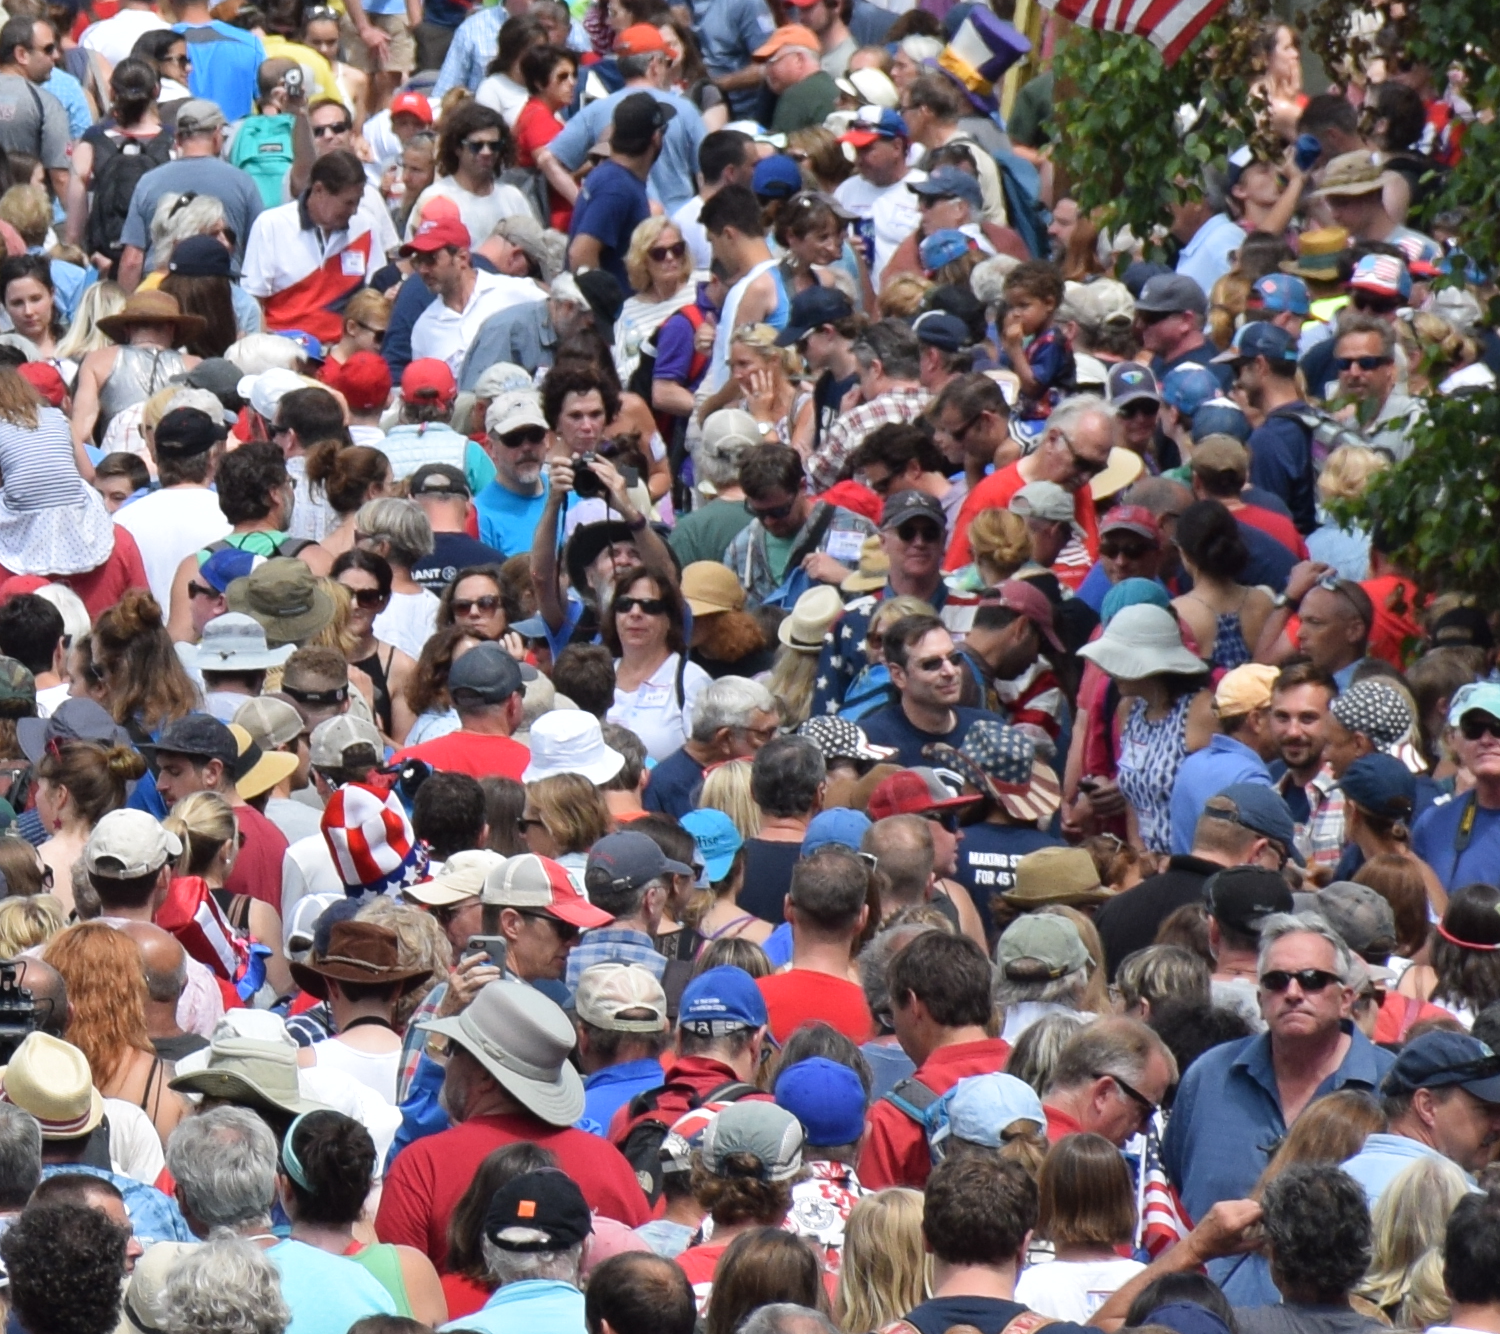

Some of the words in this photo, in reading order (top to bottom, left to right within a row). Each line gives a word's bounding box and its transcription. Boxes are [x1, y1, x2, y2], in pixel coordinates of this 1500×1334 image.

[969, 851, 1008, 869] MAKING
[975, 869, 995, 886] FOR
[996, 869, 1010, 886] 45
